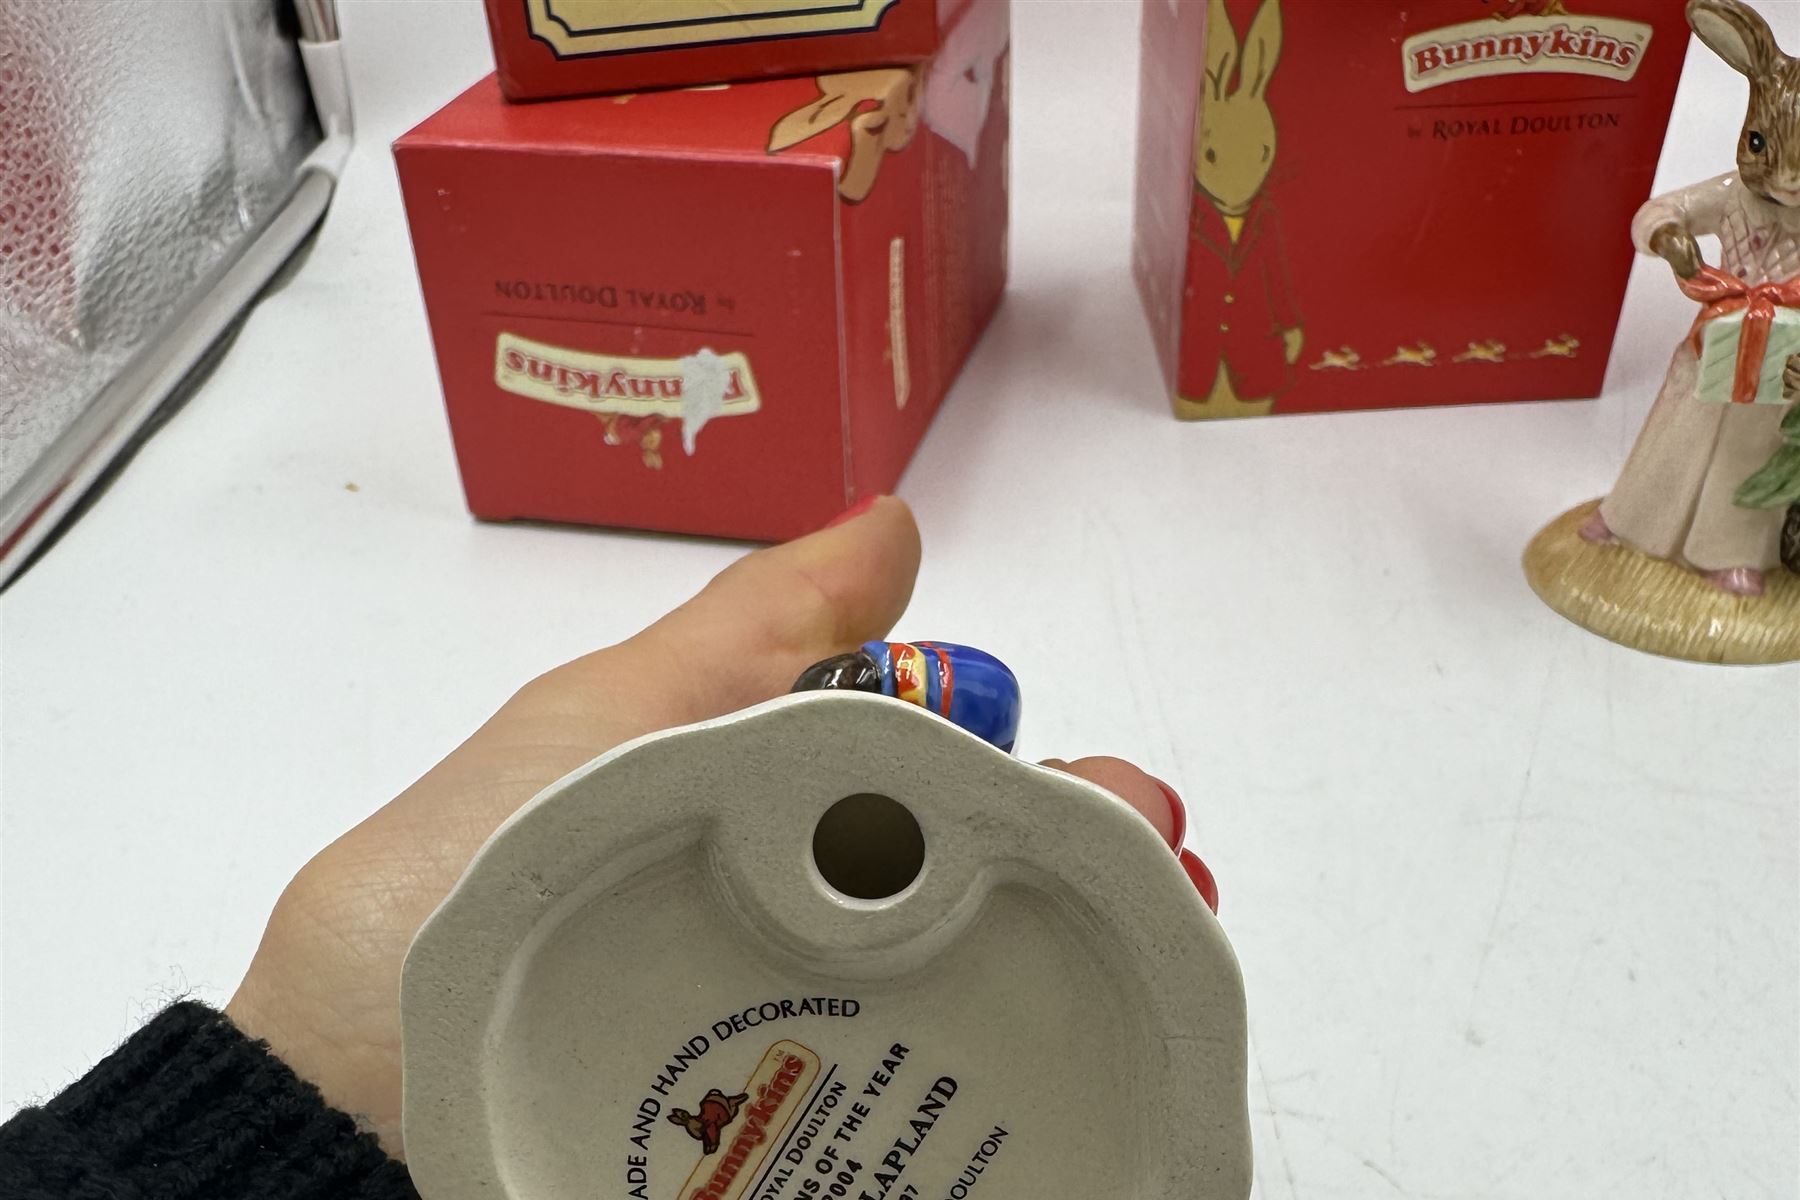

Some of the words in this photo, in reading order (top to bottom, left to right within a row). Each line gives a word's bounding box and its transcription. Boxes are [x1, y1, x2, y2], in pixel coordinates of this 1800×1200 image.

[1410, 24, 1638, 76] Bunnykins
[1432, 119, 1502, 140] ROYAL
[1509, 112, 1622, 135] DOULTON
[494, 280, 618, 309] DOULTON
[626, 289, 706, 315] ROYAL
[629, 1096, 662, 1152] AND
[650, 1034, 712, 1096] HAND
[711, 997, 862, 1042] DECORATED
[788, 1080, 848, 1168] DOULTON
[814, 1145, 841, 1176] OF
[832, 1101, 872, 1143] THE
[862, 1041, 911, 1101] YEAR
